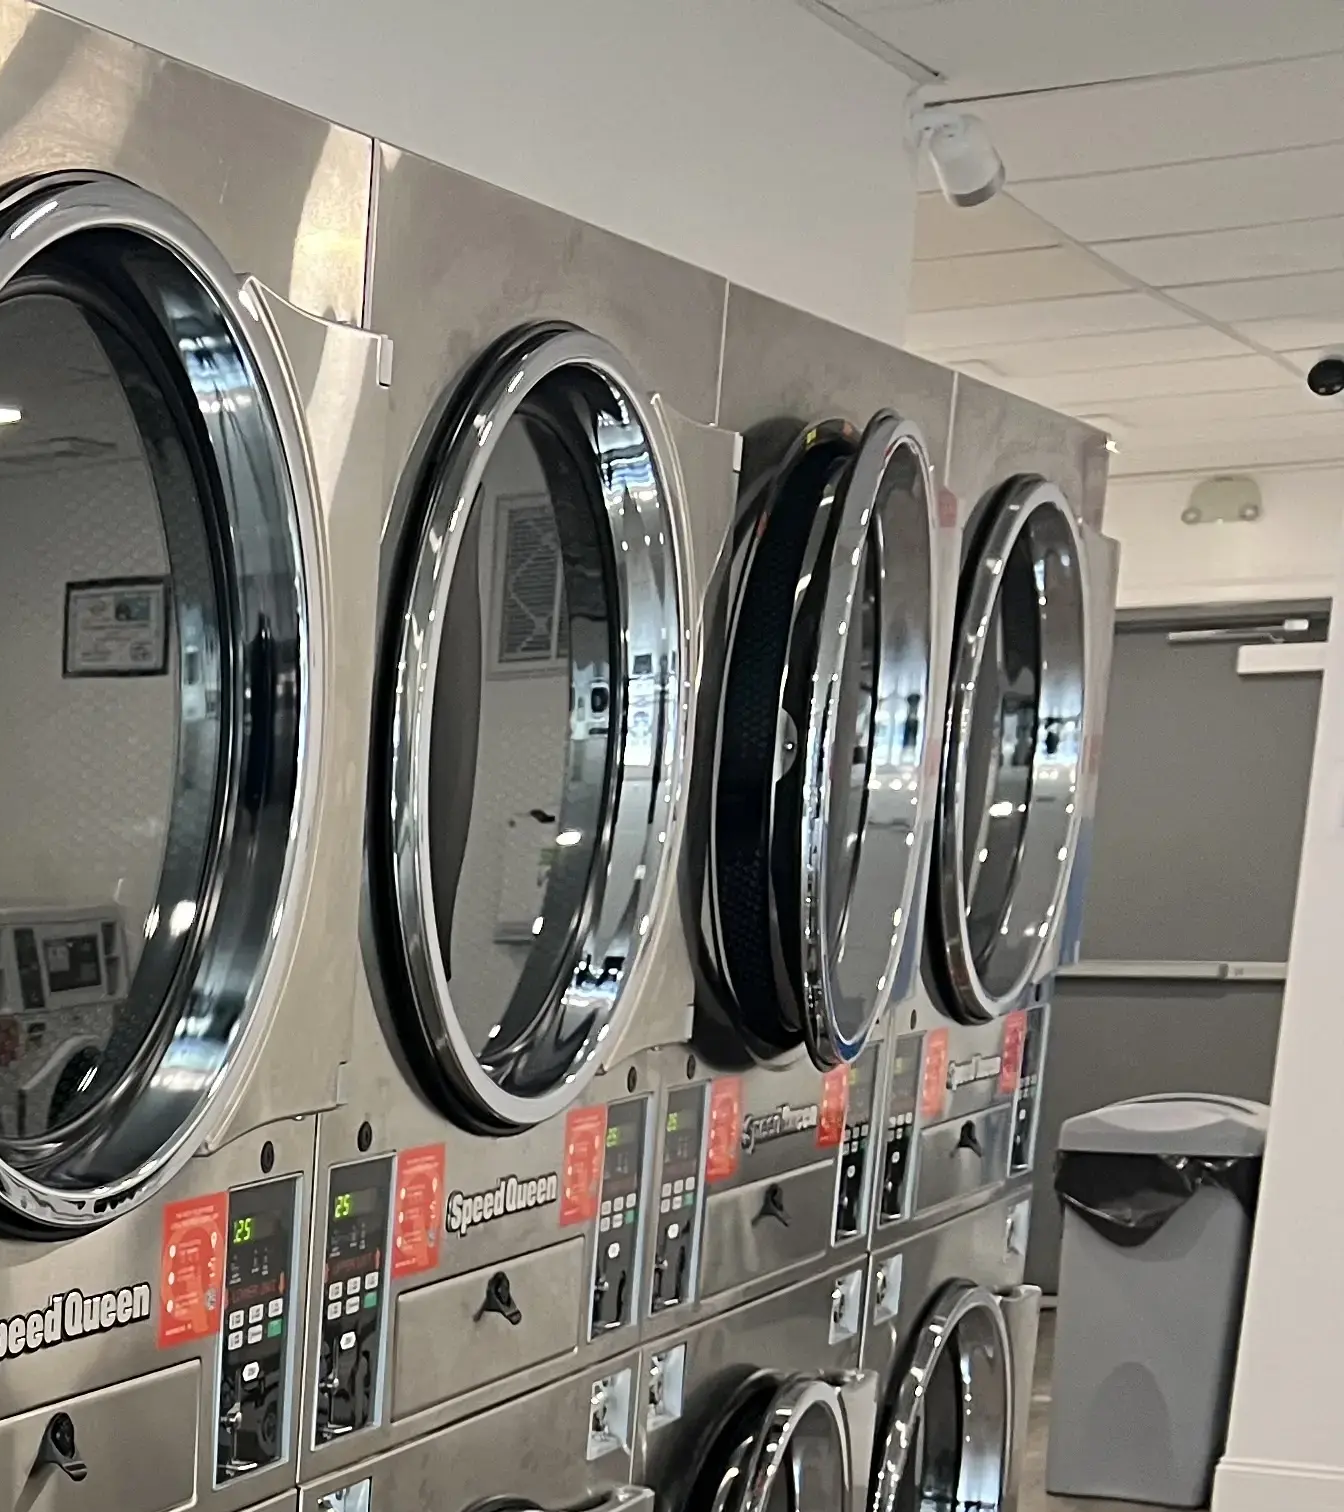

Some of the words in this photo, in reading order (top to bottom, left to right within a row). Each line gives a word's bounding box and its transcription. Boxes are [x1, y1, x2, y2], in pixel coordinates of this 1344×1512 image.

[446, 1178, 505, 1239] Speed
[506, 1171, 557, 1213] Queen
[62, 1281, 151, 1341] Queen
